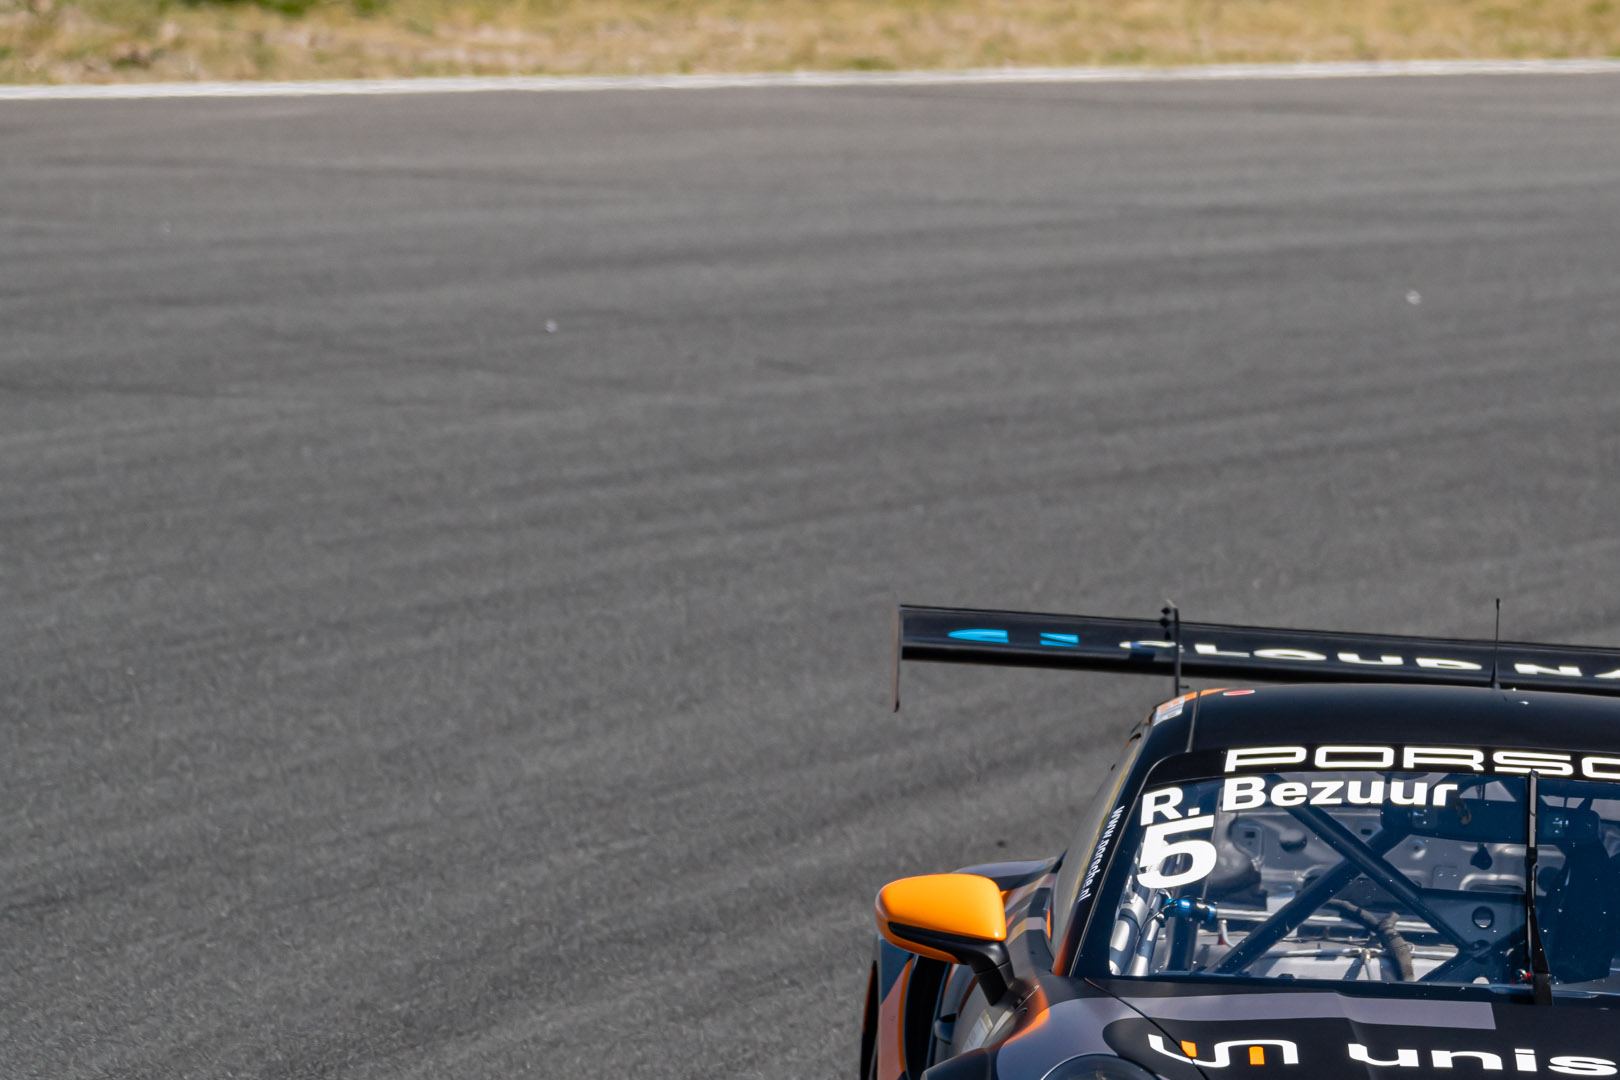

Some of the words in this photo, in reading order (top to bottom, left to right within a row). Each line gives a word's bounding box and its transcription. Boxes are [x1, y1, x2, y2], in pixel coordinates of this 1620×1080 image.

[1140, 787, 1200, 827] R.
[1222, 776, 1458, 811] Bezuur
[1137, 814, 1217, 889] 5
